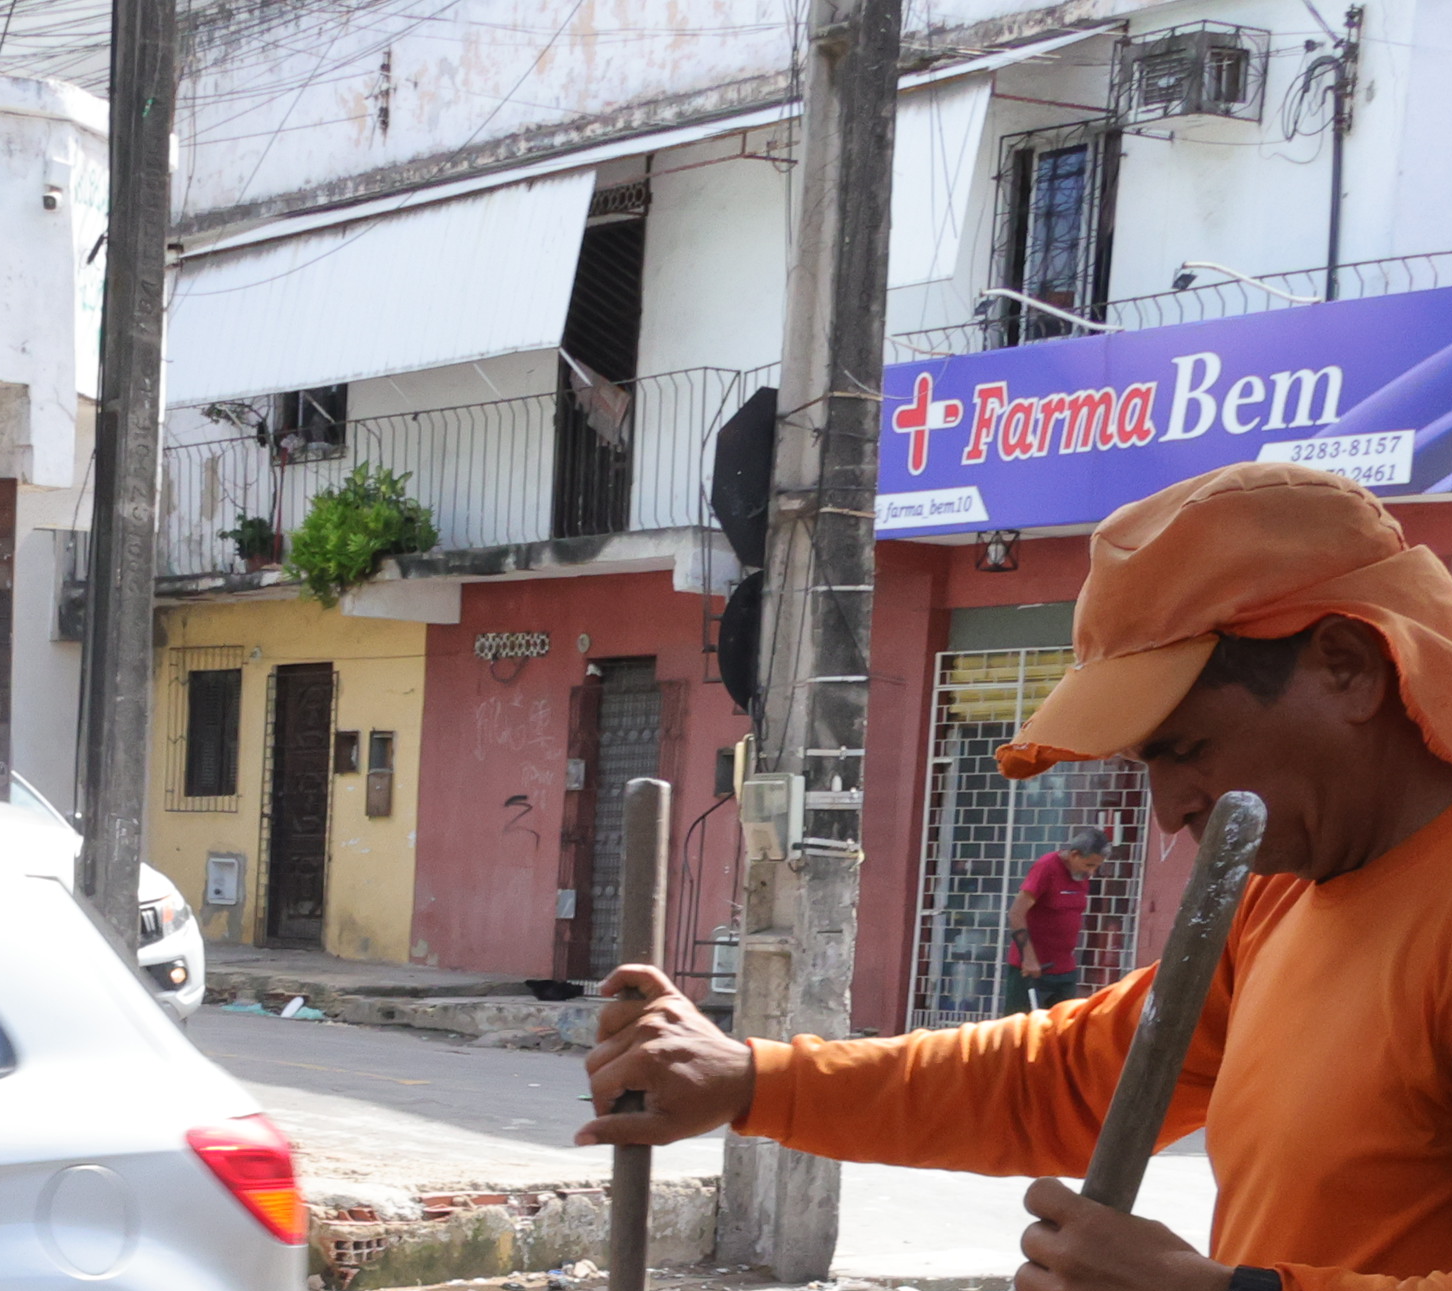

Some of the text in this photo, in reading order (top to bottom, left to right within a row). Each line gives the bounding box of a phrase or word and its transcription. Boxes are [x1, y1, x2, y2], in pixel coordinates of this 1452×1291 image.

[961, 351, 1344, 465] Farma Bem
[1291, 435, 1402, 462] 3283-8157
